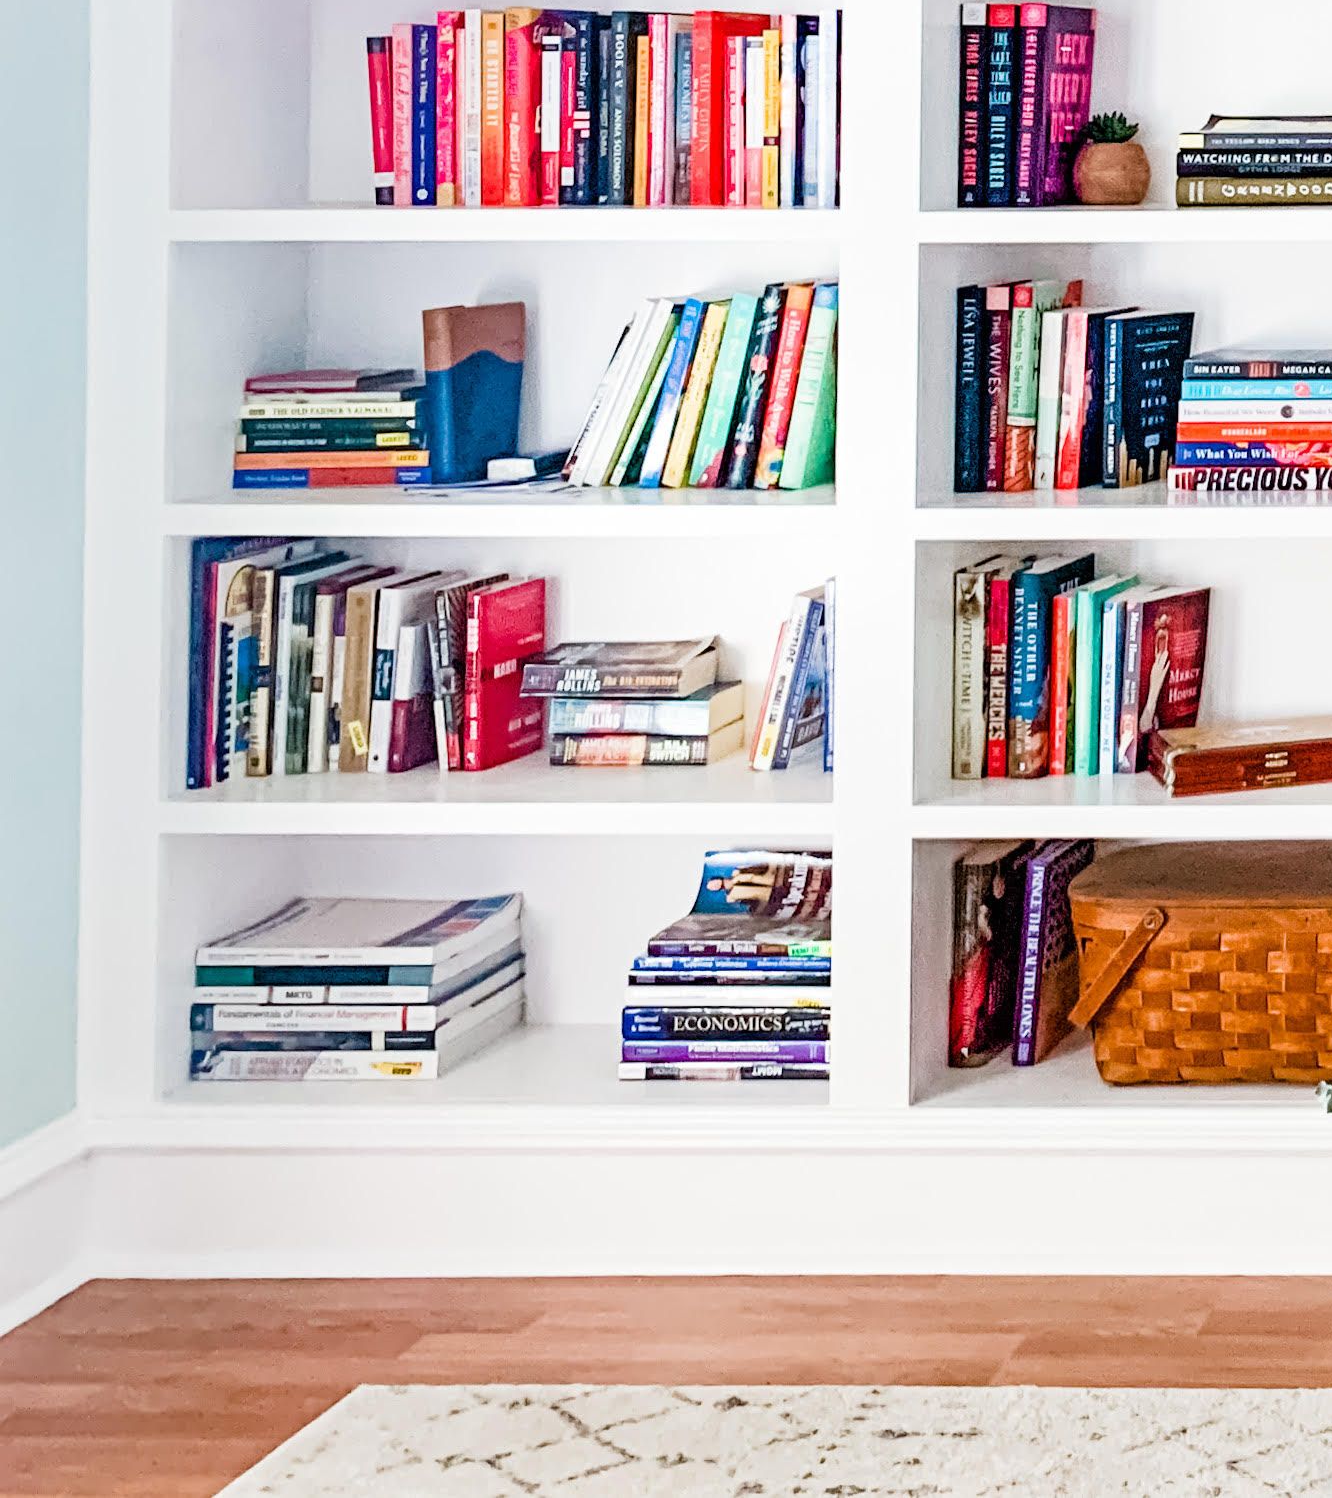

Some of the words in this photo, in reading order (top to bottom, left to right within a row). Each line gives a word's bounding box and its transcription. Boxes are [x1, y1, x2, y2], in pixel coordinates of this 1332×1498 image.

[965, 33, 979, 66] FINAL
[965, 69, 978, 102] GIRLS
[991, 116, 1006, 149] RILEY
[989, 153, 1006, 188] SAGER
[1182, 154, 1253, 165] WATCHING
[1291, 154, 1316, 163] THE
[963, 299, 977, 329] LISA
[991, 316, 1002, 335] THE
[1015, 310, 1024, 348] Nothing
[962, 333, 976, 382] JEWELL
[988, 342, 1003, 394] WIVES
[1013, 366, 1023, 385] See
[1013, 388, 1023, 410] Here
[1195, 449, 1223, 459] What
[1226, 450, 1245, 459] You
[1248, 449, 1276, 459] Wish
[1194, 467, 1309, 491] PRECIOUS
[1027, 602, 1037, 631] THE
[991, 643, 1005, 673] THE
[1026, 635, 1037, 681] OTHER
[990, 677, 1005, 740] MERCIES
[1028, 865, 1045, 910] PRINCE
[1026, 912, 1041, 939] THE
[1021, 939, 1039, 1010] BEAUTIFUL
[673, 1015, 783, 1032] ECONOMICS
[1019, 1011, 1033, 1039] ONES
